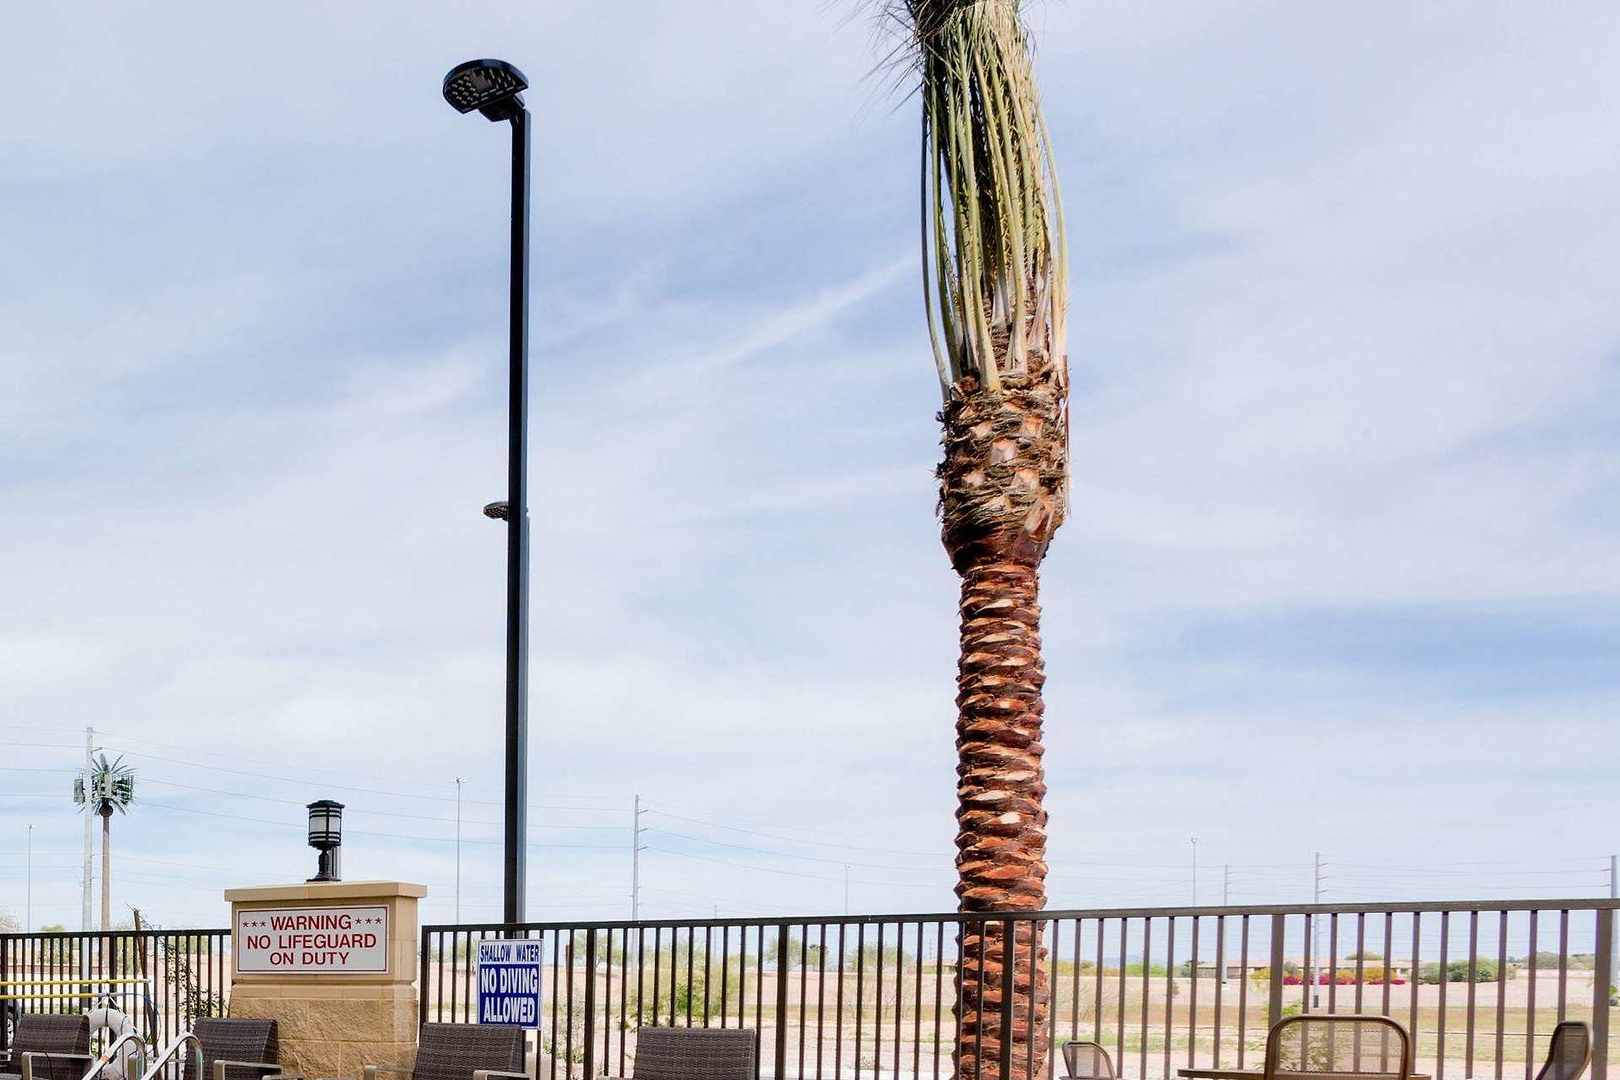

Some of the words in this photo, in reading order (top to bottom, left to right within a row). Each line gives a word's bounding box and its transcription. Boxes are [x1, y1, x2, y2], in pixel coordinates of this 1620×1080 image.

[271, 914, 351, 931] WARNING
[247, 935, 271, 949] NO
[279, 934, 377, 949] LIFEGUARD
[269, 952, 294, 965] ON
[302, 952, 349, 965] DUTY
[480, 945, 512, 962] SHALLOW
[516, 945, 539, 962] WATER
[481, 968, 497, 994] NO
[500, 968, 538, 994] DIVING
[483, 996, 535, 1023] ALLOWED
